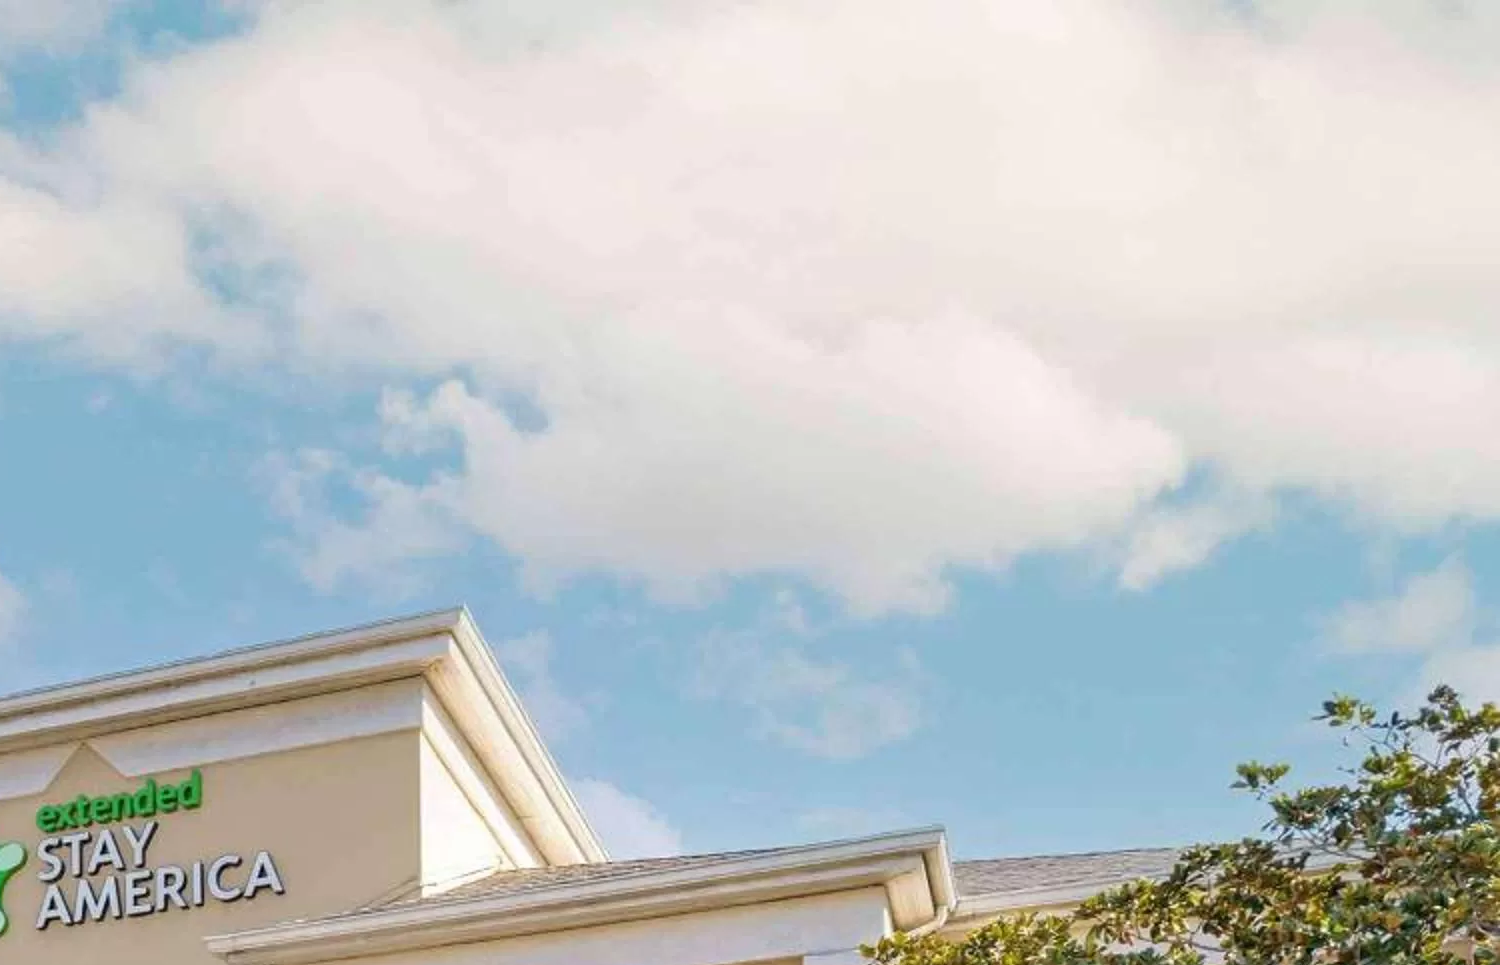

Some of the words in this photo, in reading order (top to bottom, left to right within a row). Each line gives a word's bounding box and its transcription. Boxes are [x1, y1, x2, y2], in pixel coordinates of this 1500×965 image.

[36, 769, 201, 832] extended
[36, 821, 159, 884] STAY
[35, 851, 285, 930] AMERICA
